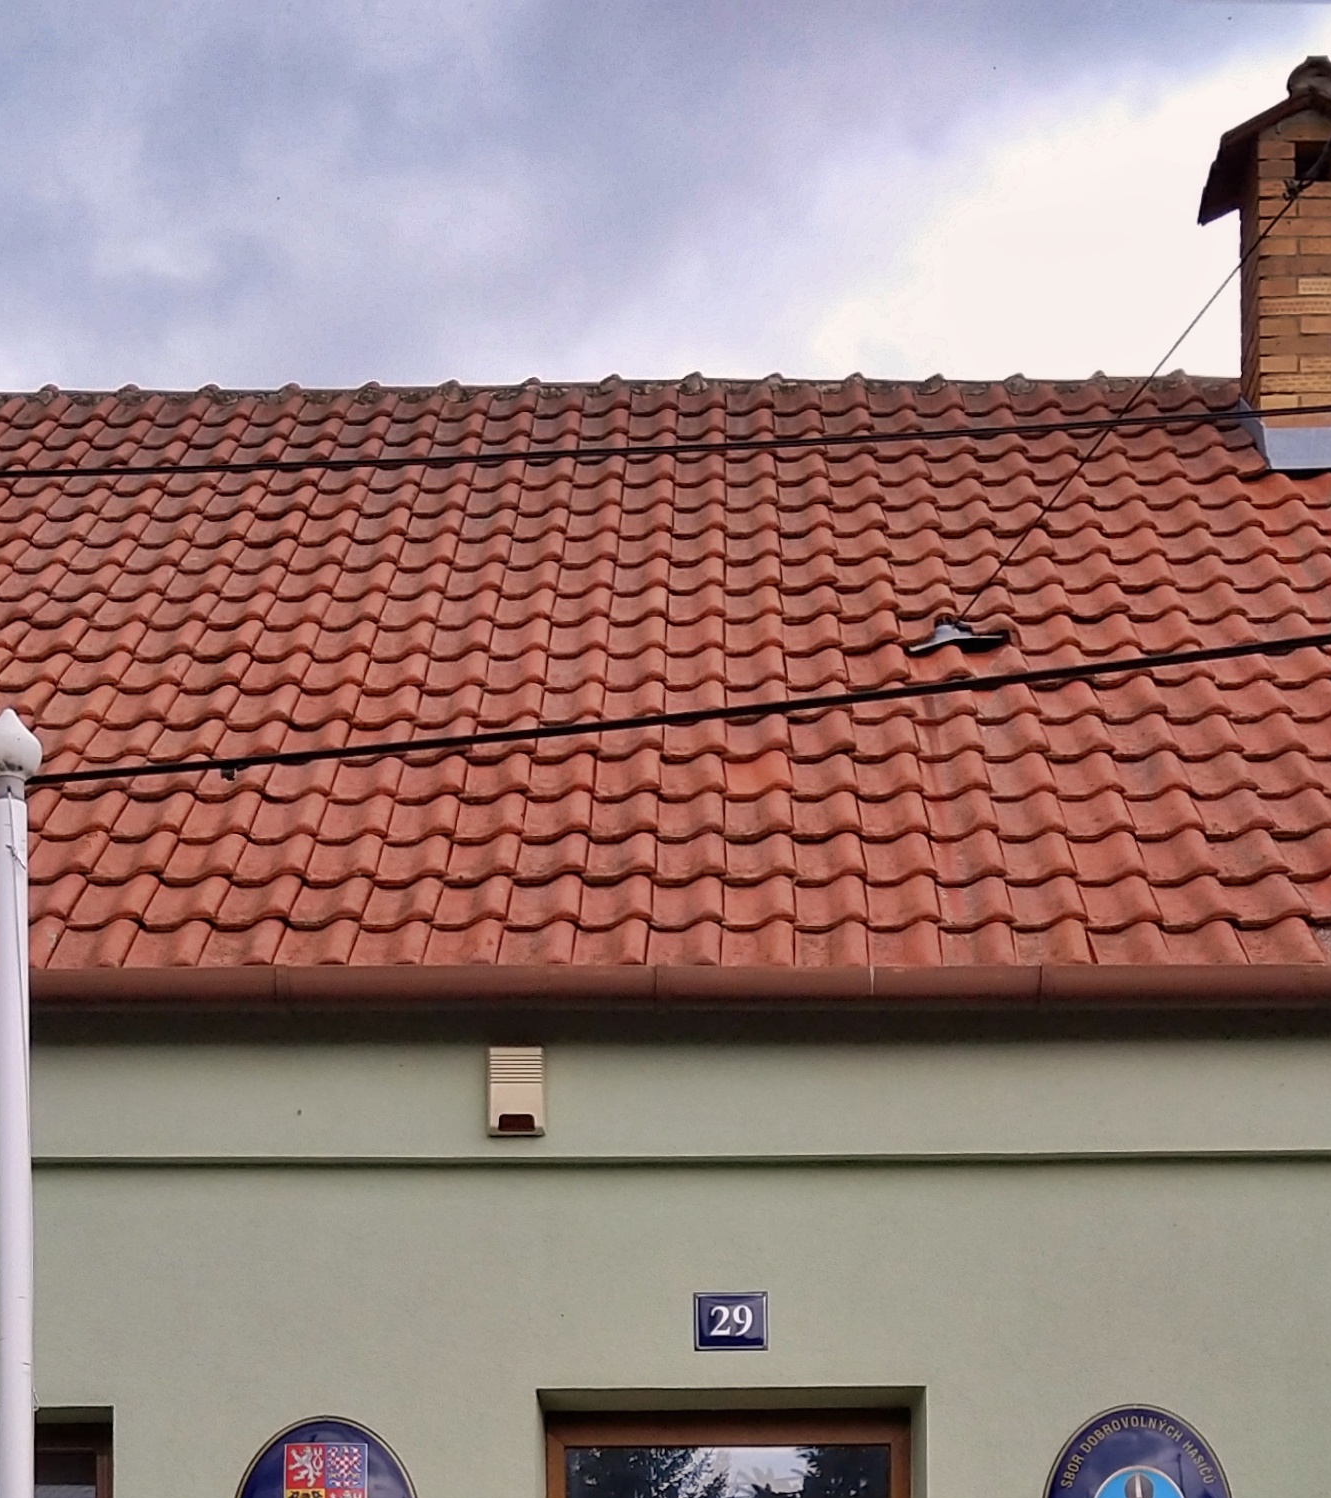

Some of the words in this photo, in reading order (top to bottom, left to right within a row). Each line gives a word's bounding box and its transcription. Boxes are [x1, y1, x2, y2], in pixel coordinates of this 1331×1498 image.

[709, 1304, 753, 1337] 29
[1060, 1453, 1085, 1489] SBOR
[1079, 1415, 1182, 1454] DOBROVOLNÝCH
